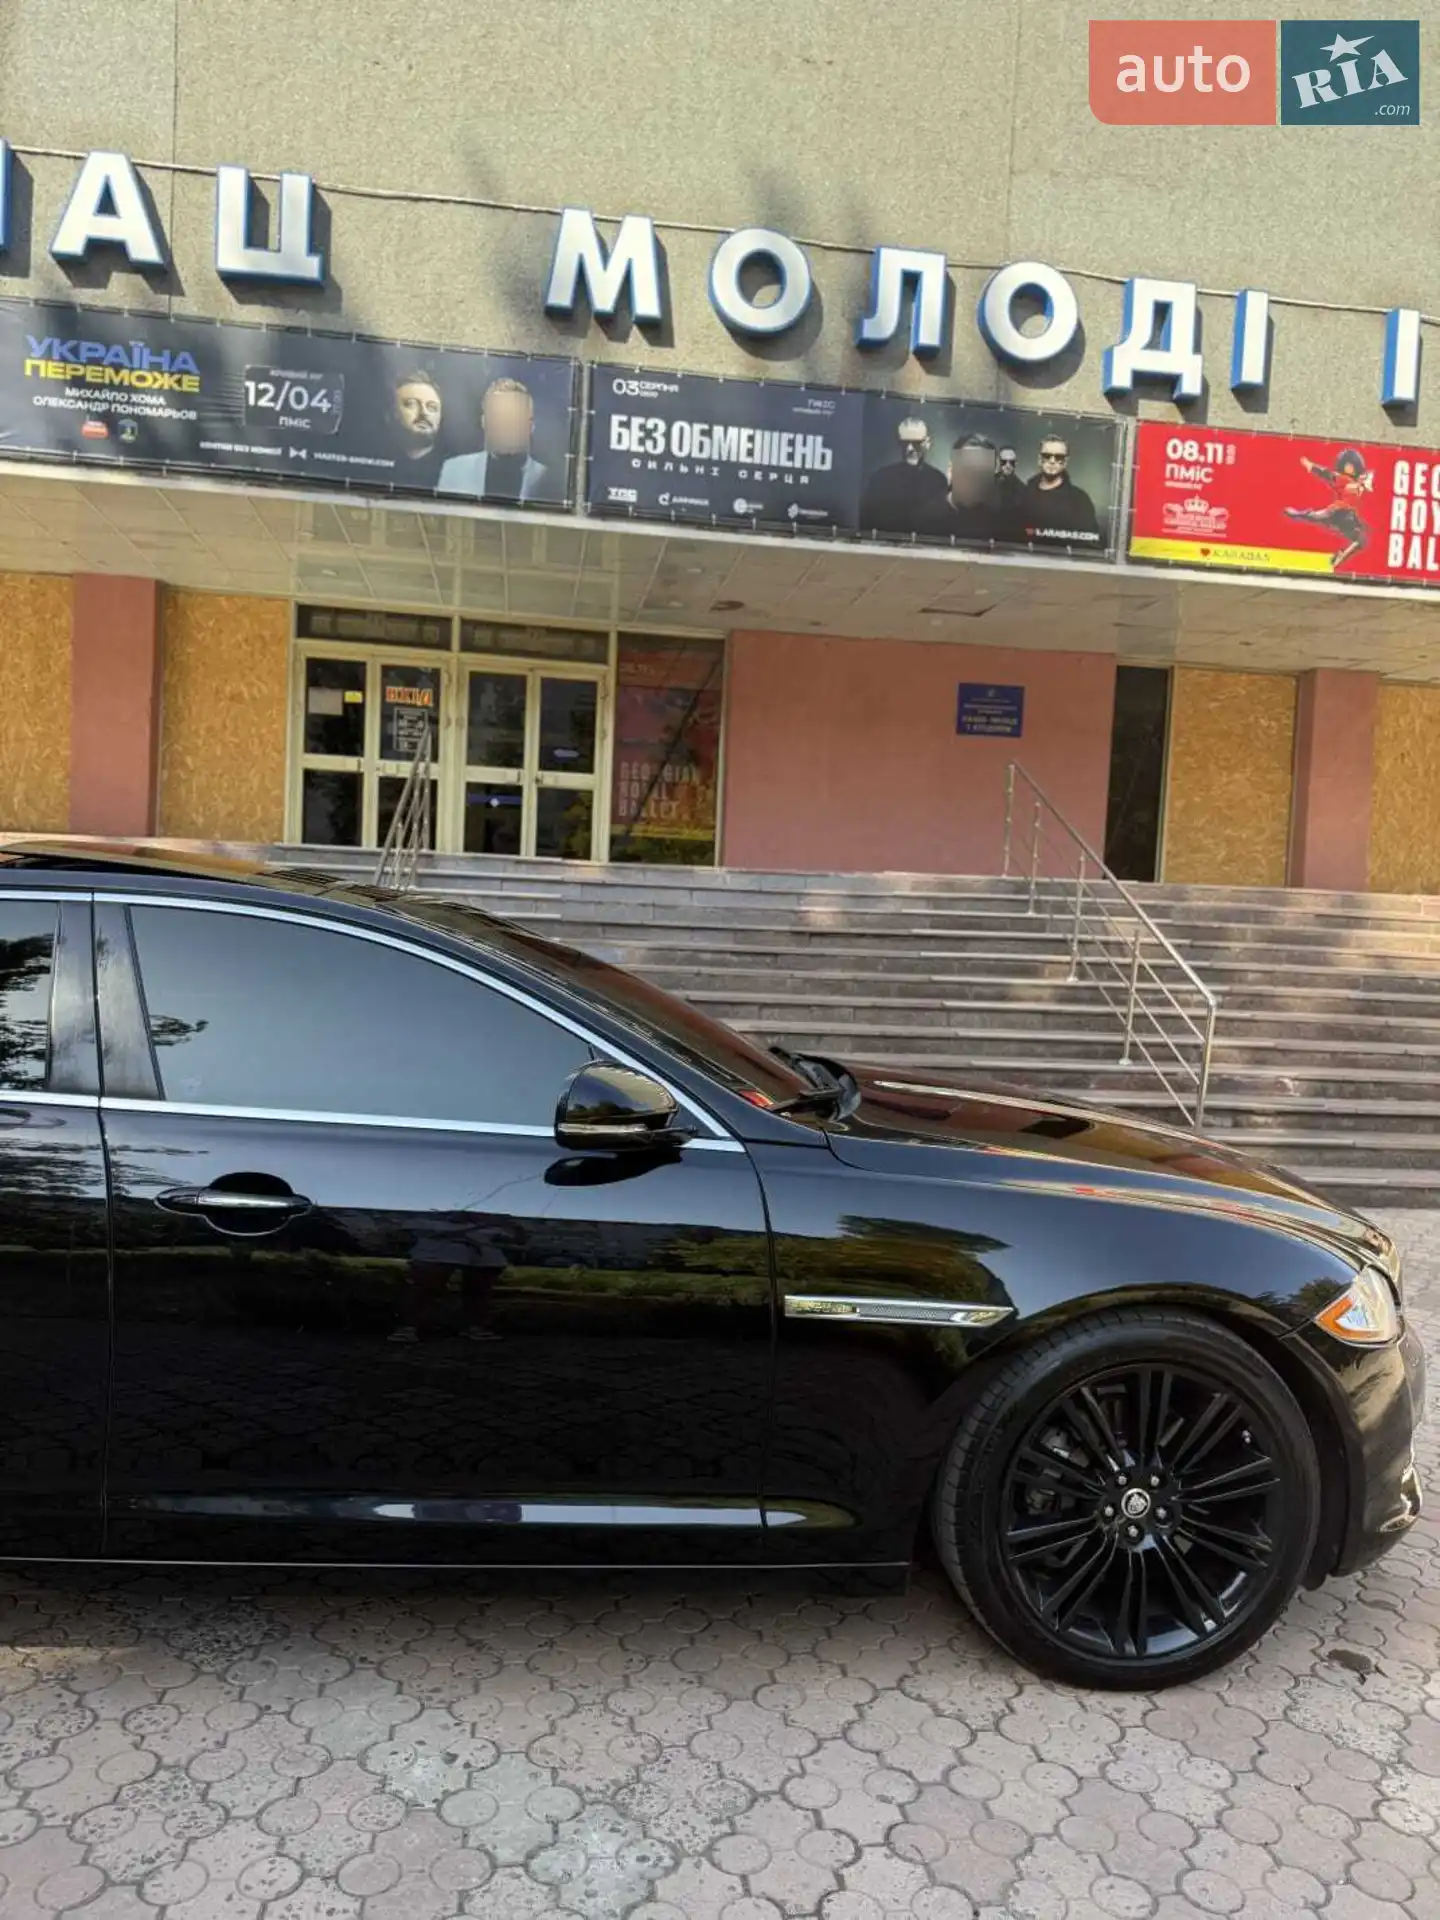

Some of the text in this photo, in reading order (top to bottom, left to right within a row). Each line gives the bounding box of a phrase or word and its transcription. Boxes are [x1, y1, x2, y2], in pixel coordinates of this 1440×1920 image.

[0, 139, 324, 285] АЦ
[545, 207, 1269, 399] МОЛОДІ
[26, 334, 200, 373] УКРАЇНА
[24, 358, 200, 393] ПЕРЕМОЖЕ
[613, 379, 639, 396] 03
[65, 387, 167, 406] МИХАЙЛО ХОМА
[244, 380, 332, 413] 12/04
[610, 413, 666, 454] БЕЗ
[1166, 438, 1224, 465] 08.11
